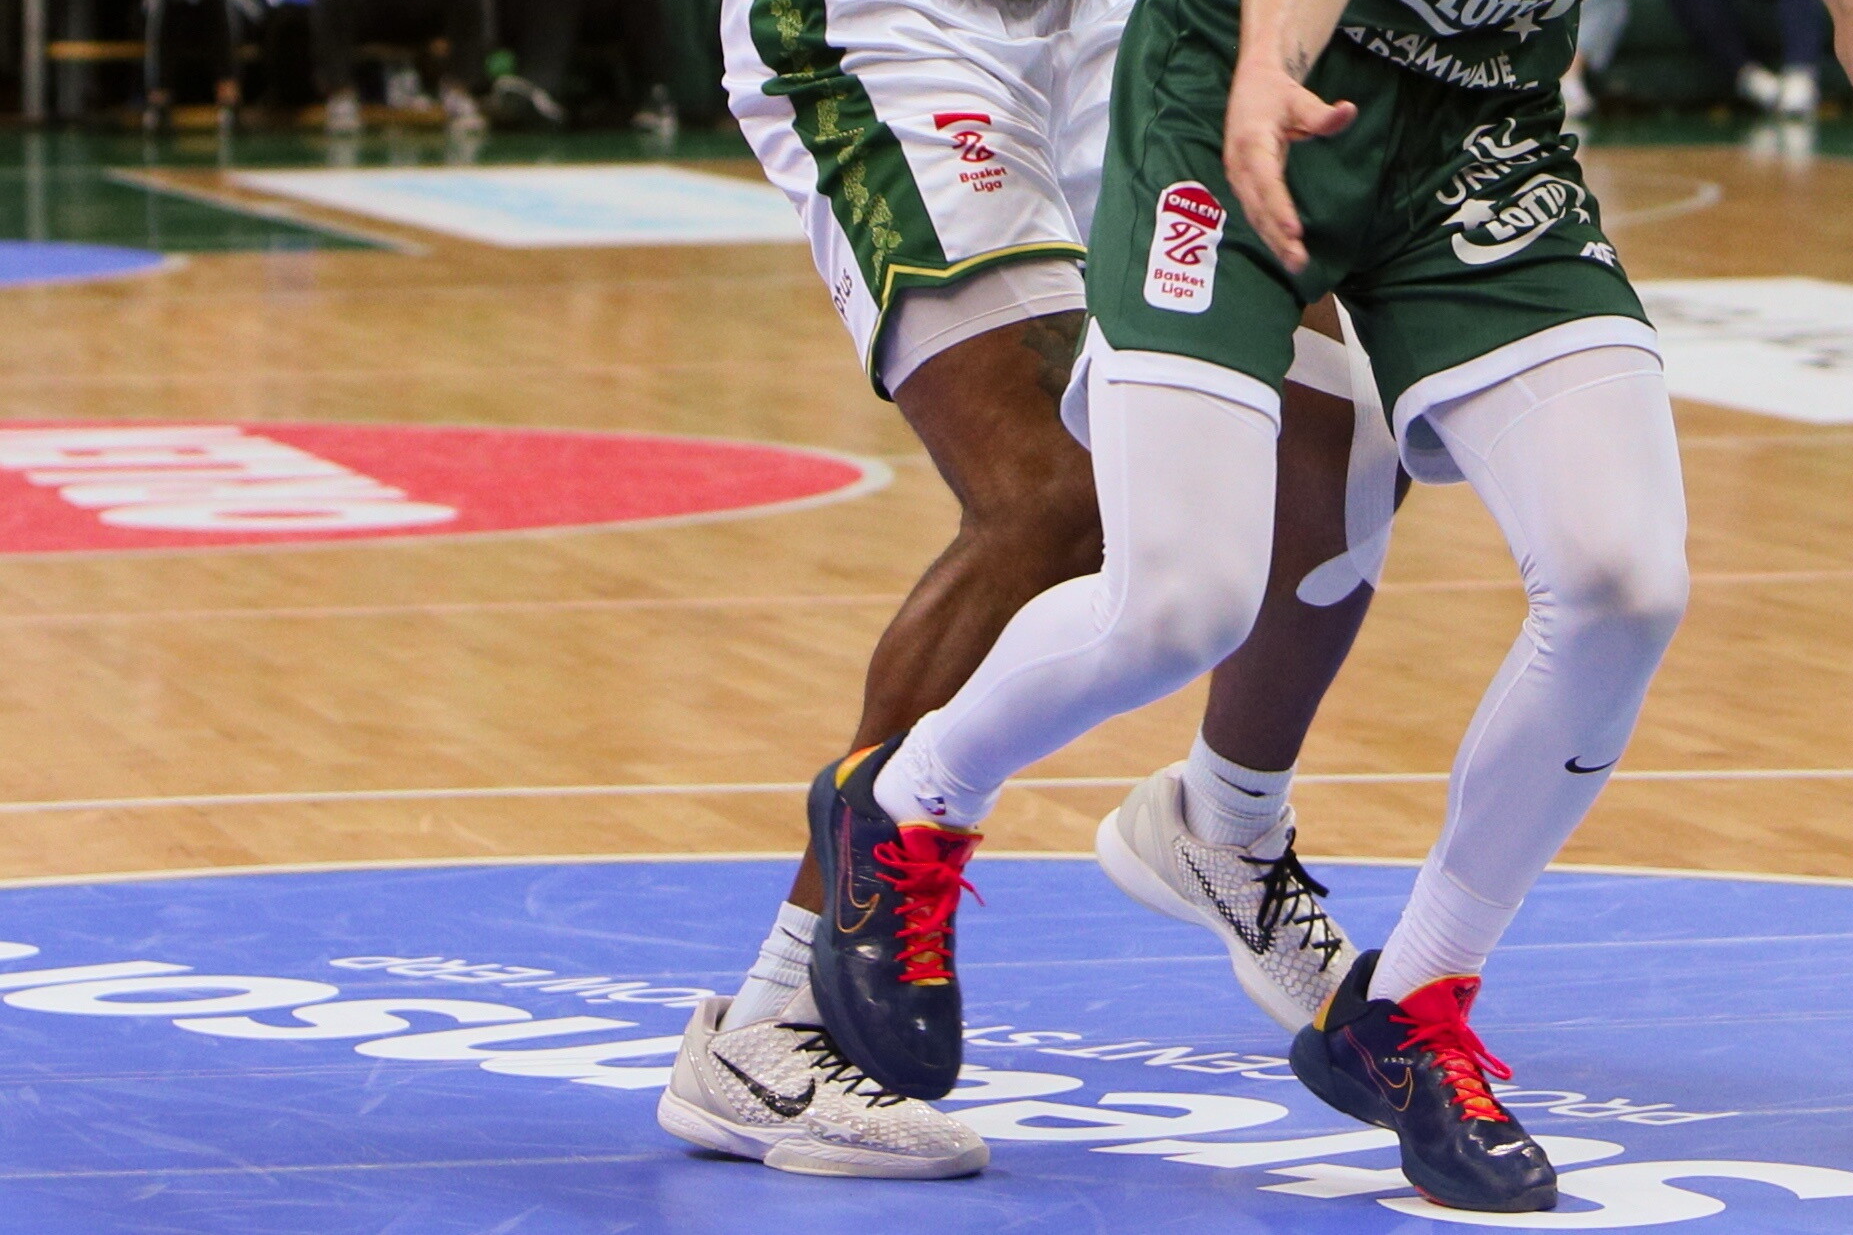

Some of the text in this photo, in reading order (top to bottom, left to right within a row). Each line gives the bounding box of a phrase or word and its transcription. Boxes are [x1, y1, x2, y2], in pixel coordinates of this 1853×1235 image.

[959, 166, 1008, 183] Basket
[973, 180, 1003, 192] Liga
[1168, 194, 1220, 221] ORLEN
[1485, 182, 1567, 242] LOTTO
[1154, 268, 1205, 289] Basket
[1161, 282, 1194, 298] Liga
